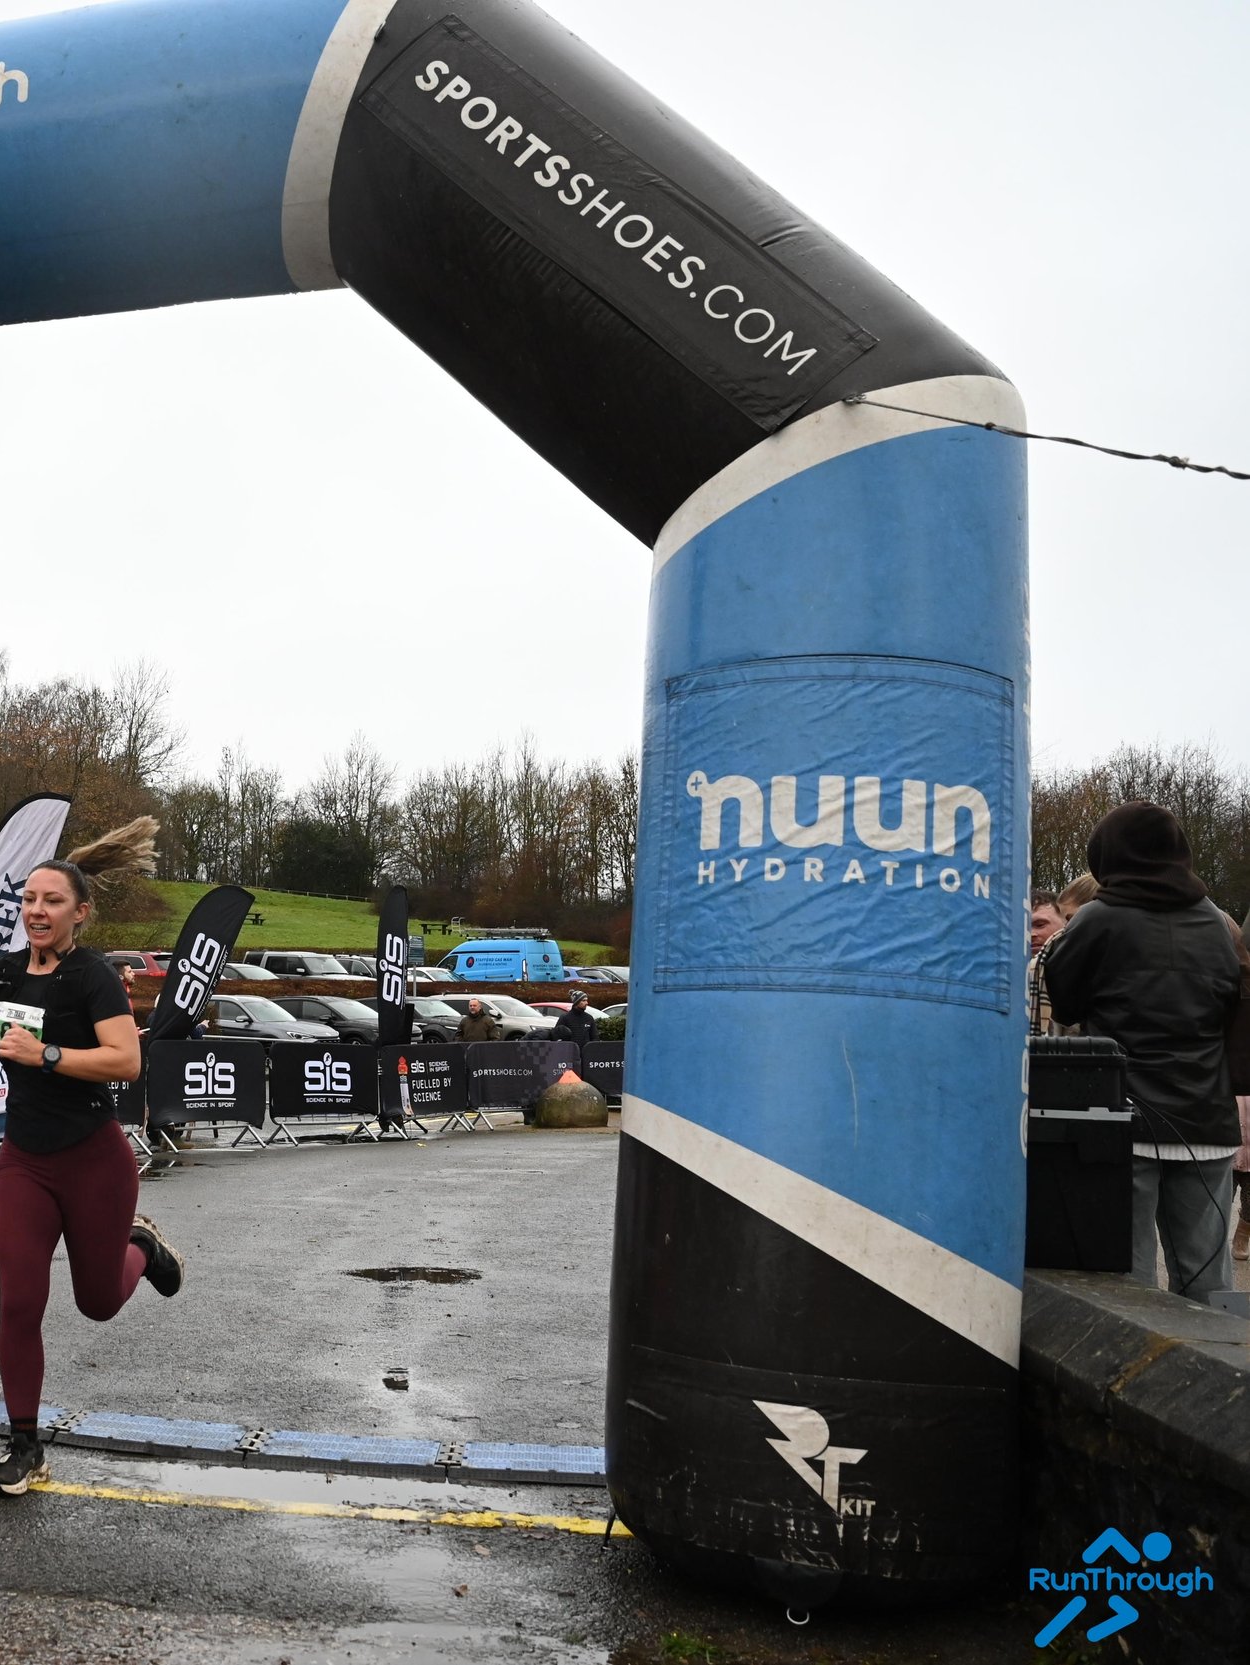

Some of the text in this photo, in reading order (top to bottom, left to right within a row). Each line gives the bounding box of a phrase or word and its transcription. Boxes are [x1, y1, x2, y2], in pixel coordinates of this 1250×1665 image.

[415, 60, 817, 376] SPORTSSHOES.COM
[687, 770, 991, 864] nuun
[697, 857, 990, 899] HYDRATION
[412, 1078, 452, 1089] FUELLED BY
[413, 1091, 441, 1103] SCIENCE
[840, 1498, 876, 1517] KIT
